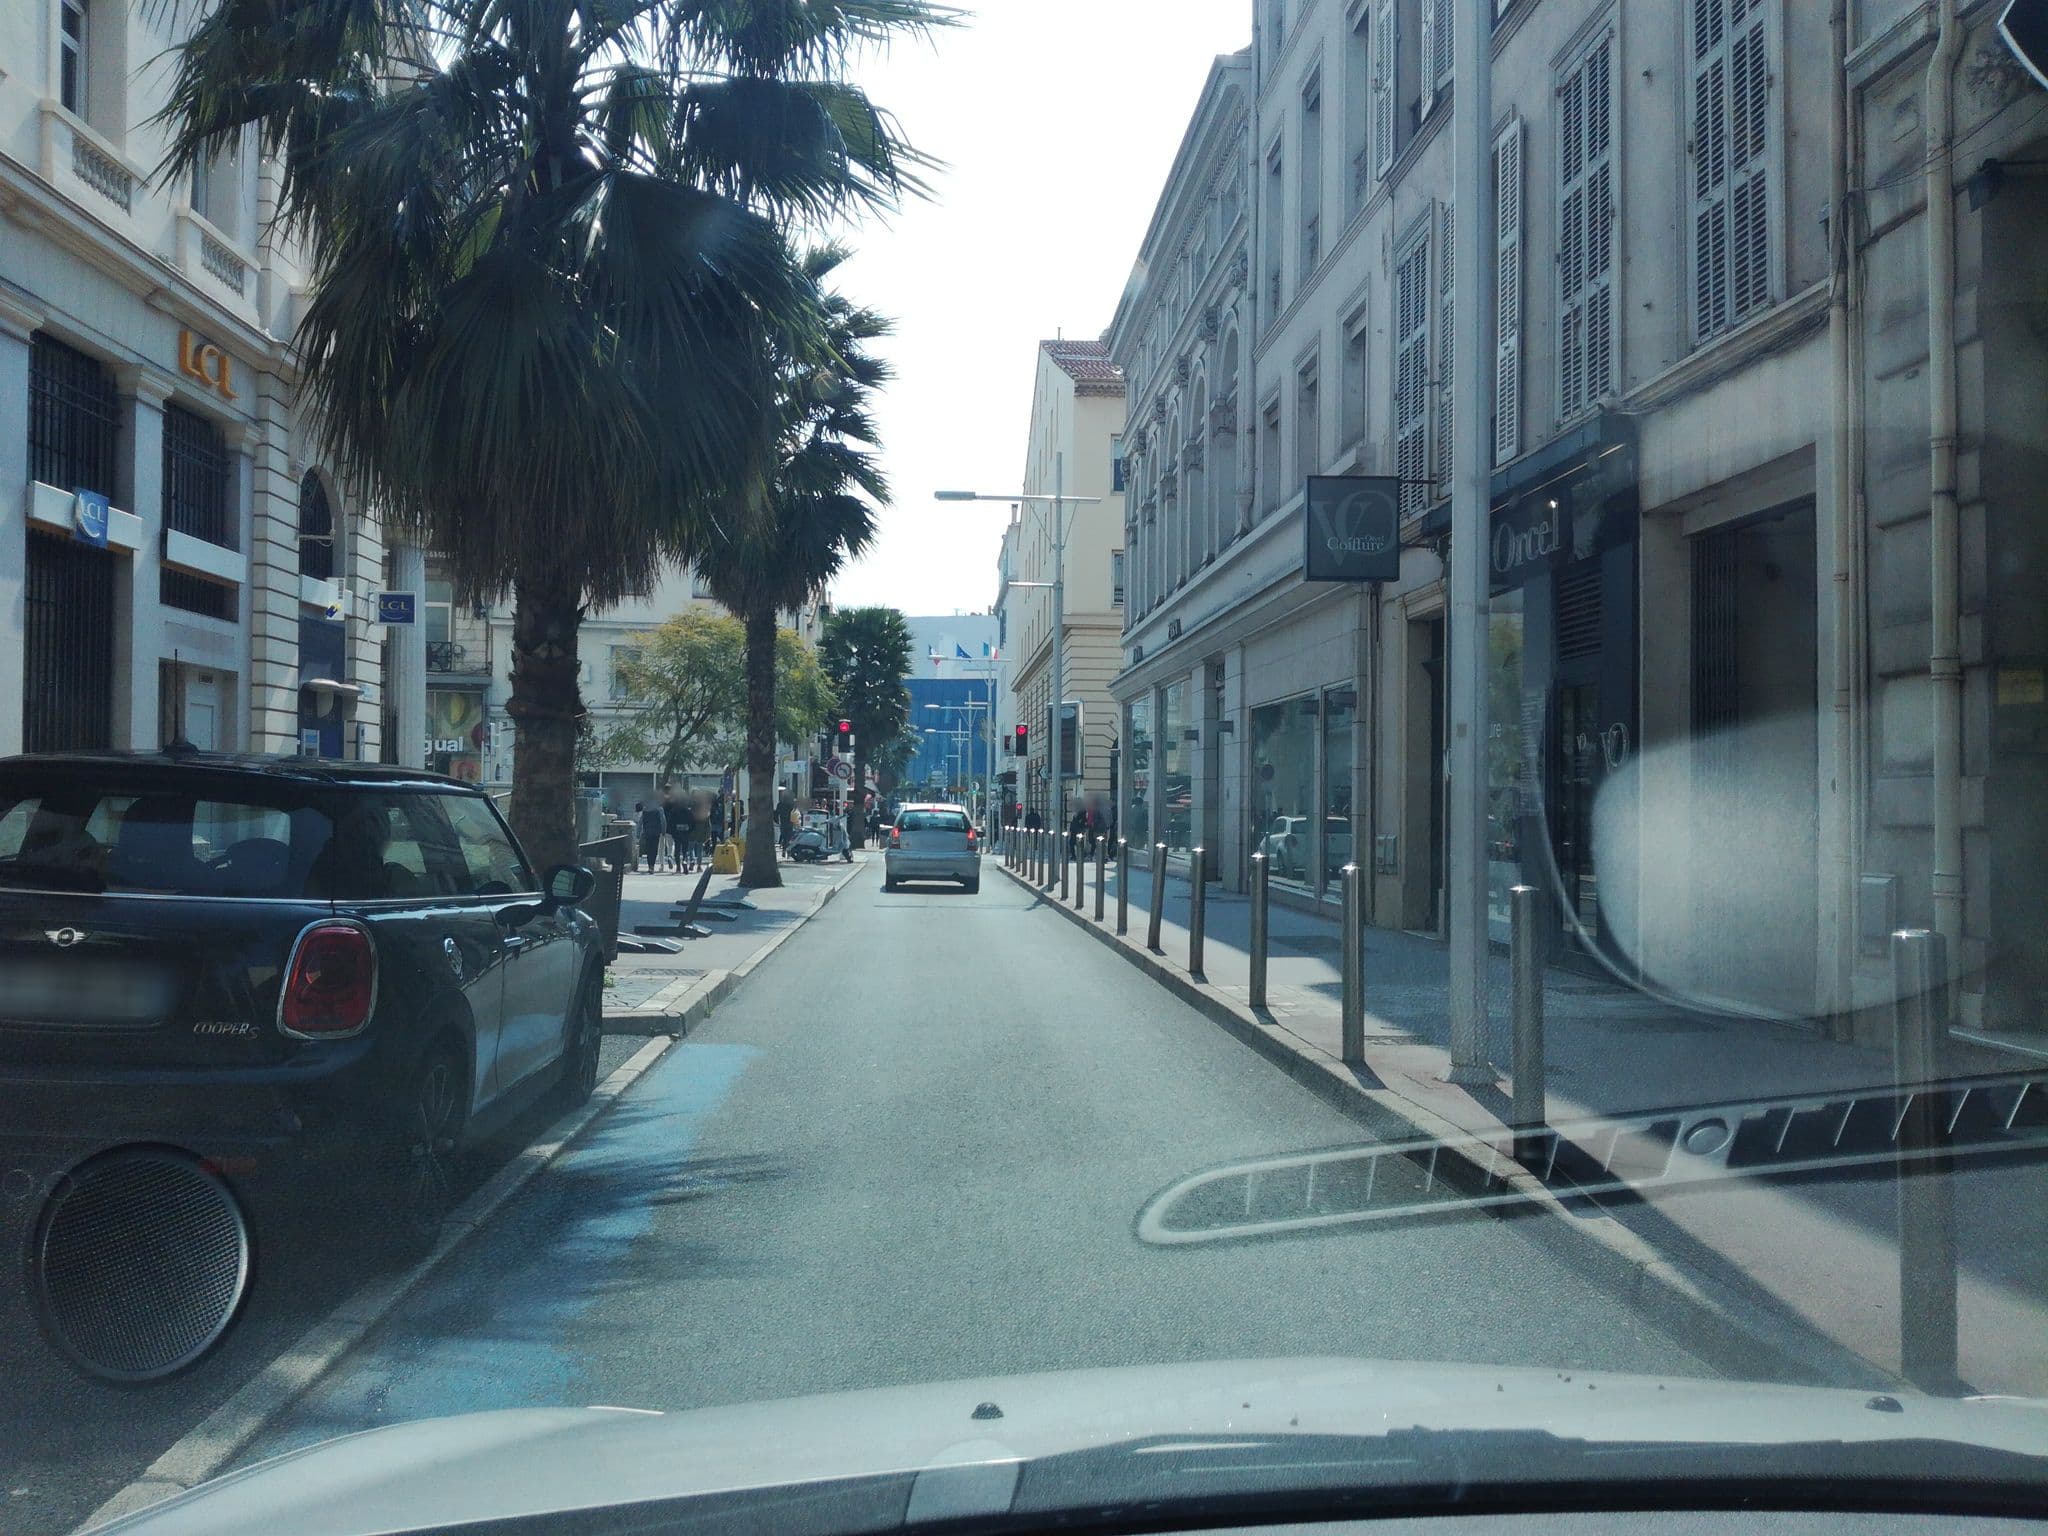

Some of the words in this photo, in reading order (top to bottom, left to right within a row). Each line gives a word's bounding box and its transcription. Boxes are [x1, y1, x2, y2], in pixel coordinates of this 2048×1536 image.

[178, 330, 240, 401] LCL
[1493, 497, 1560, 573] Orcel
[1327, 536, 1384, 552] Coiffure
[380, 600, 409, 611] LCL
[193, 1022, 250, 1035] COOPER
